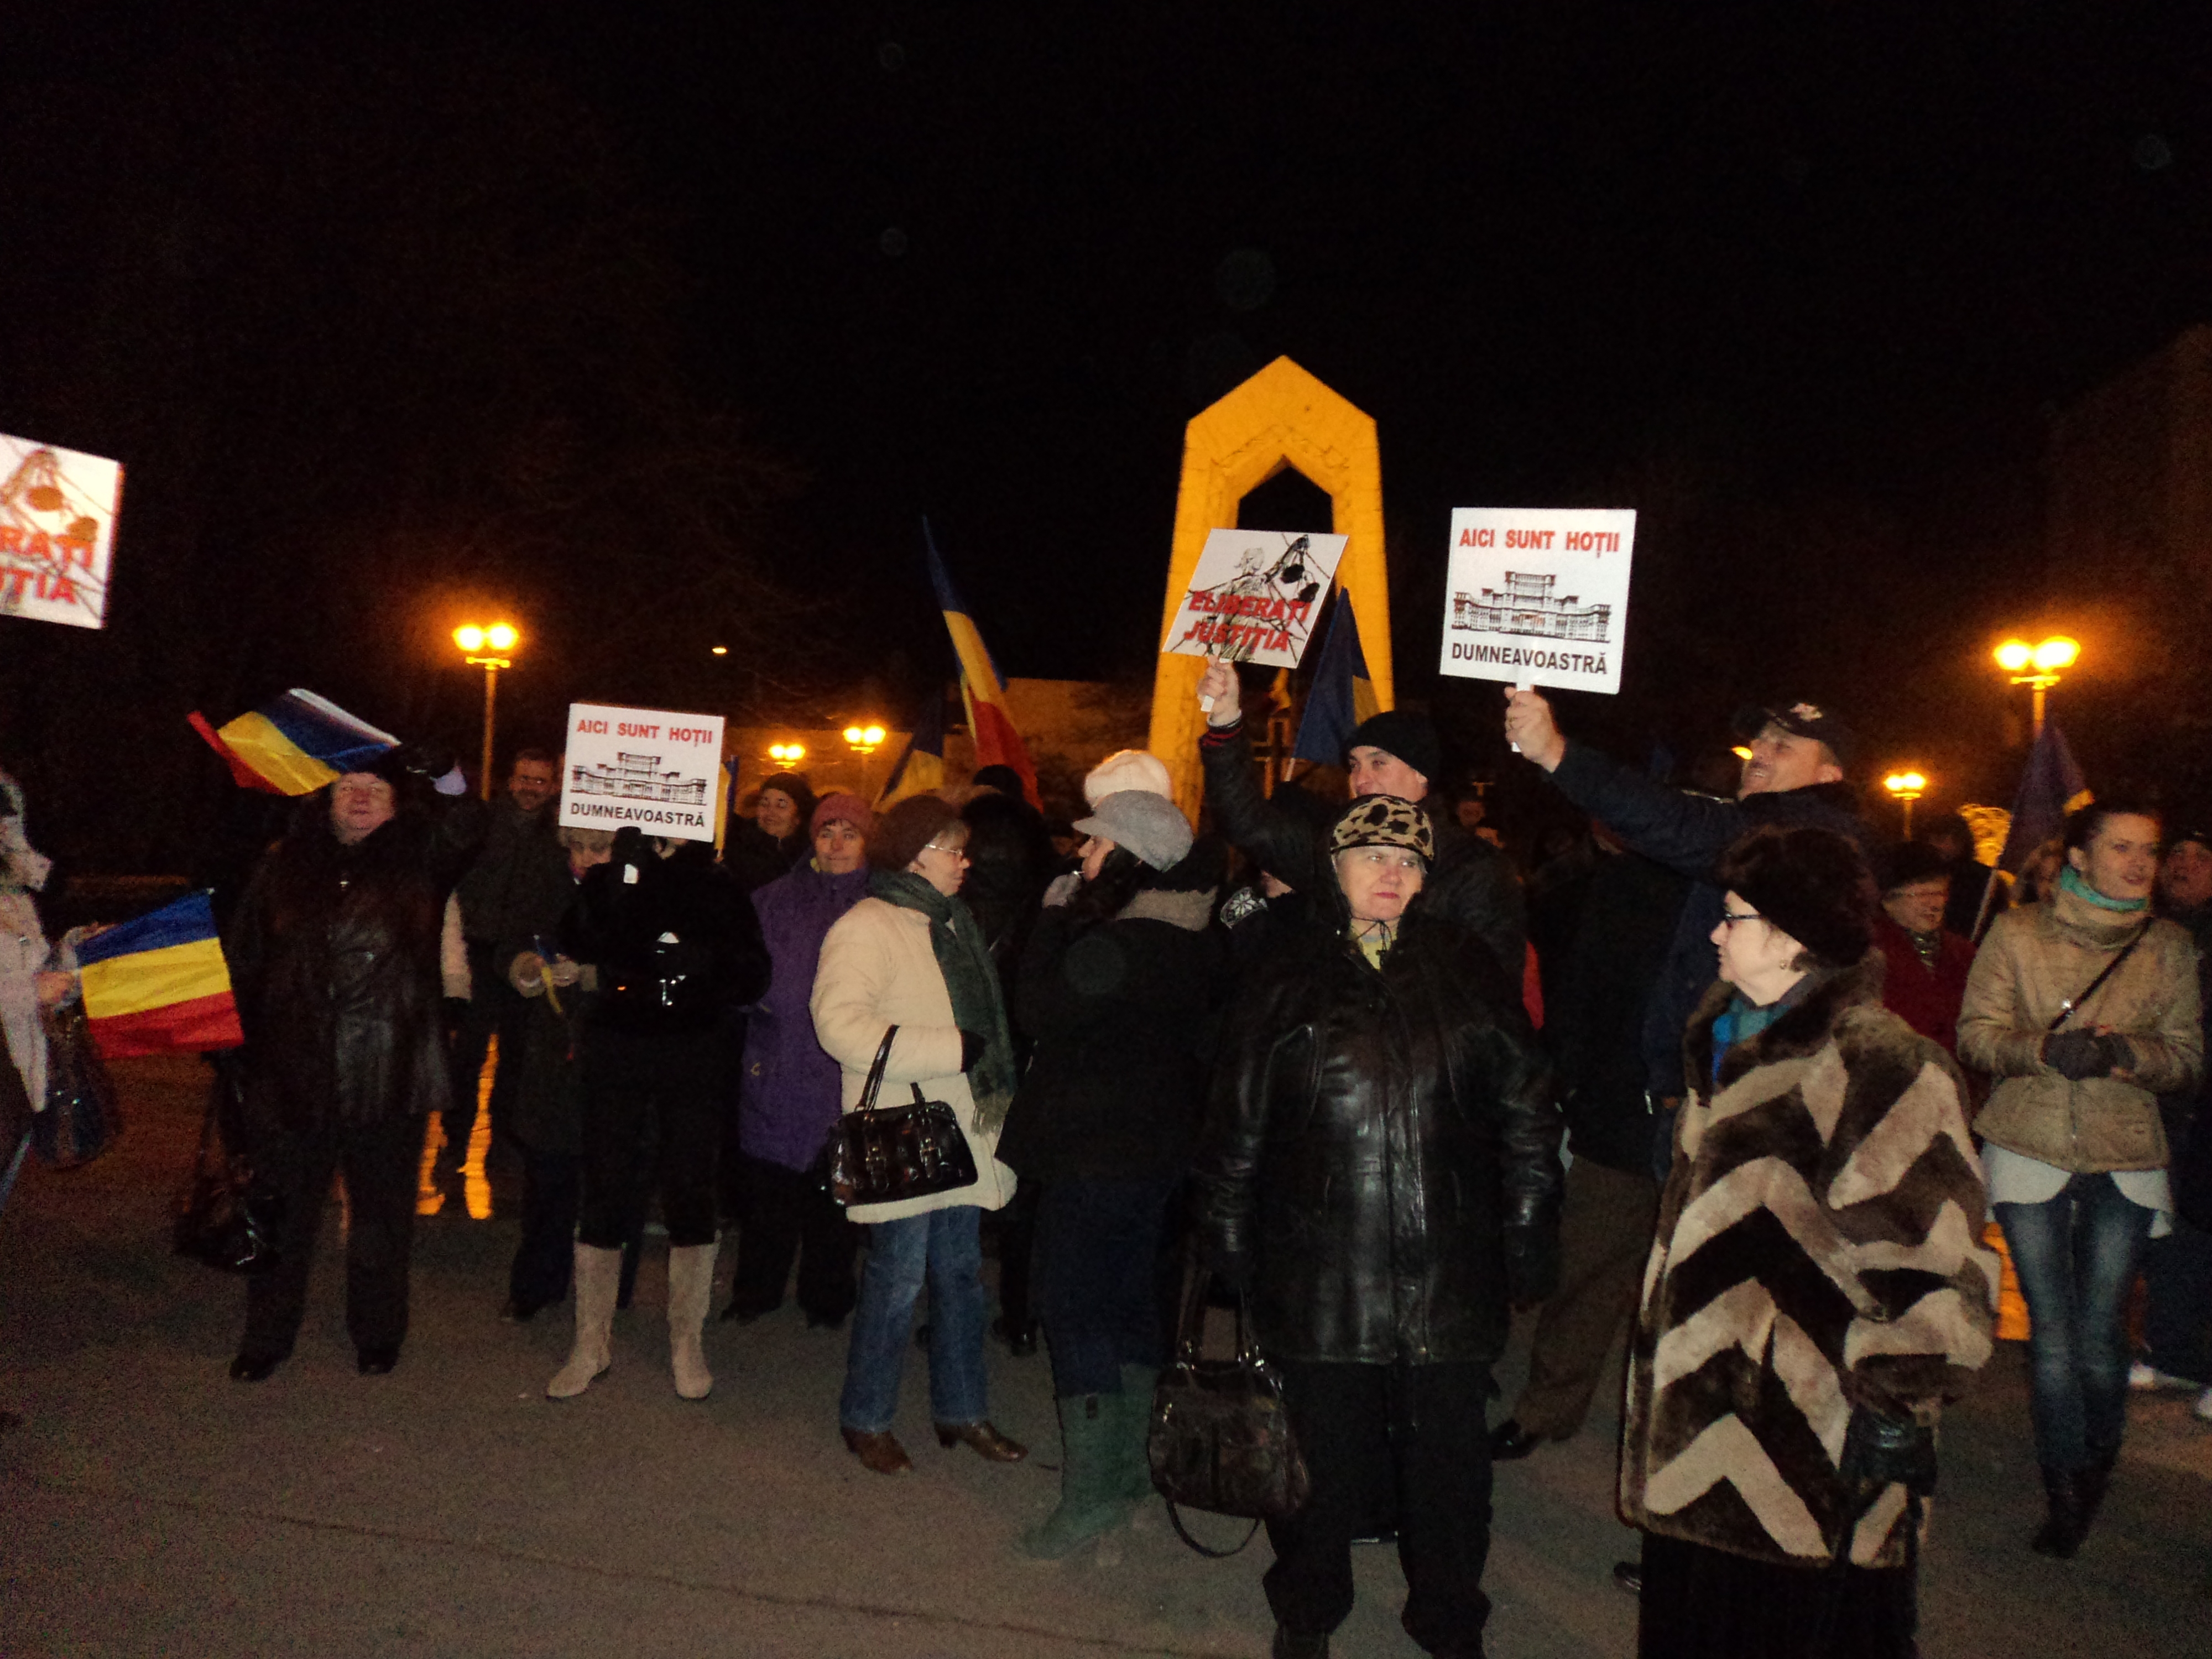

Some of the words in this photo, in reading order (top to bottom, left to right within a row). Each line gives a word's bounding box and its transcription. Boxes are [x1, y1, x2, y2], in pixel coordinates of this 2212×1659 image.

[1459, 529, 1495, 547] AICI
[1505, 530, 1556, 550] SUNT
[1452, 643, 1608, 674] DUMNEAVOASTRĂ
[577, 719, 607, 734] AICI
[617, 722, 660, 738] SUNT
[571, 802, 705, 827] DUMNEAVOASTRĂ
